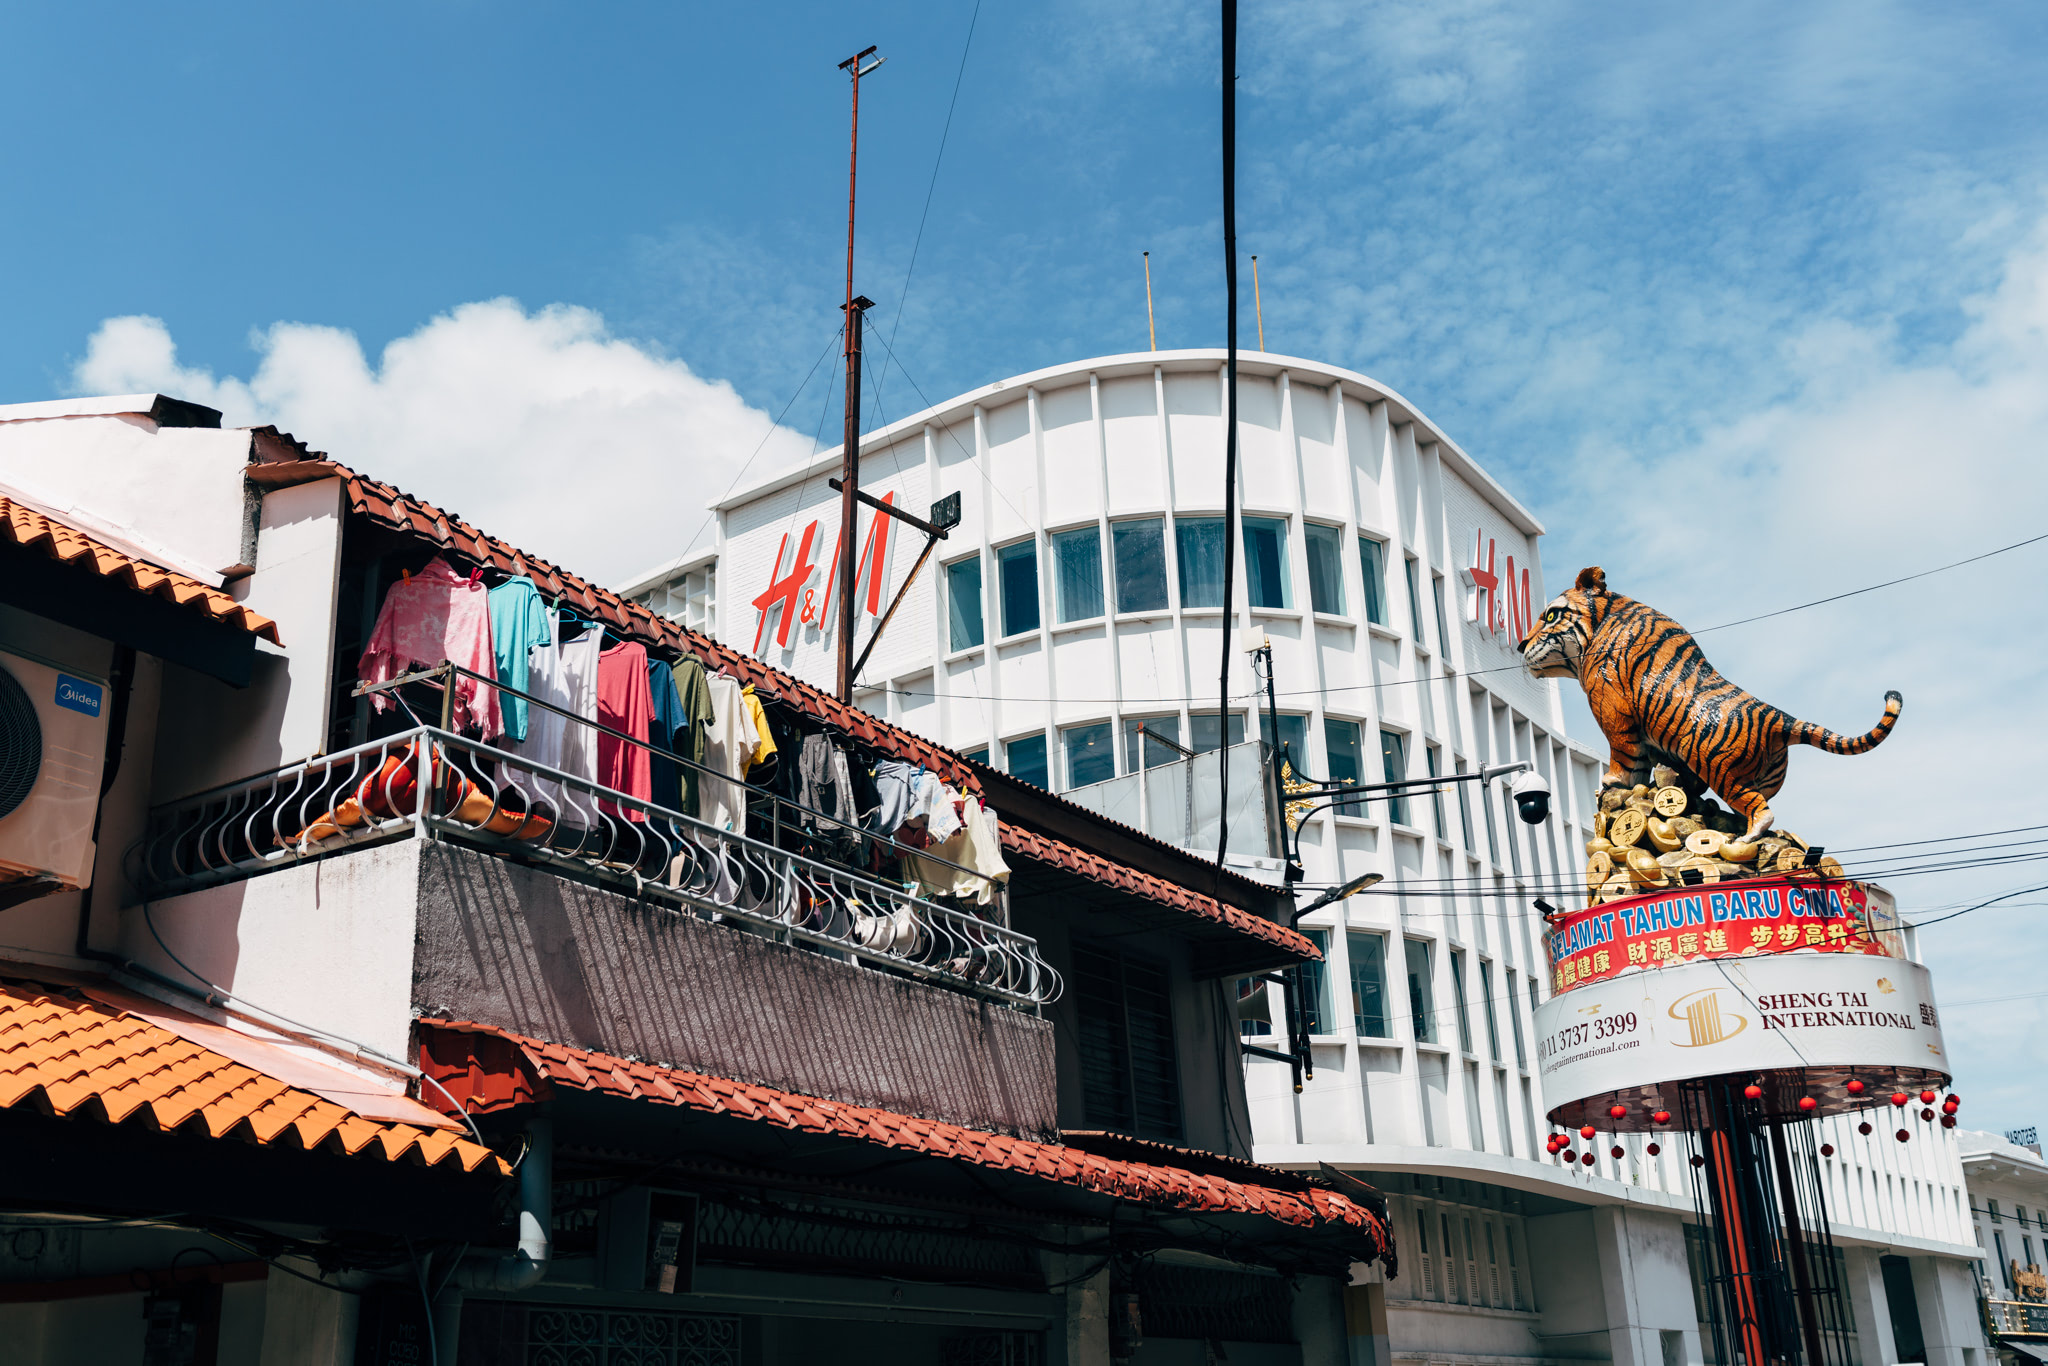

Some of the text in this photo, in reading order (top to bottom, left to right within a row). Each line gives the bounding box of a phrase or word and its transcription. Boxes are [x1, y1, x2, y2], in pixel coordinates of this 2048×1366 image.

[751, 490, 896, 655] H&M
[1468, 527, 1533, 647] H&M
[59, 683, 98, 708] Midea
[1550, 911, 1615, 963] SELAMAT
[1619, 895, 1705, 937] TAHUN
[1709, 888, 1782, 922] BARU
[1787, 887, 1846, 918] CINA
[1627, 928, 1729, 966] 財源廣進
[1750, 923, 1848, 948] 步步高升
[1758, 992, 1869, 1011] SHENG TAI
[1760, 1011, 1916, 1031] INTERNATIONAL
[1546, 1034, 1558, 1057] 11
[1558, 1022, 1589, 1051] 3737
[1594, 1012, 1637, 1040] 3399
